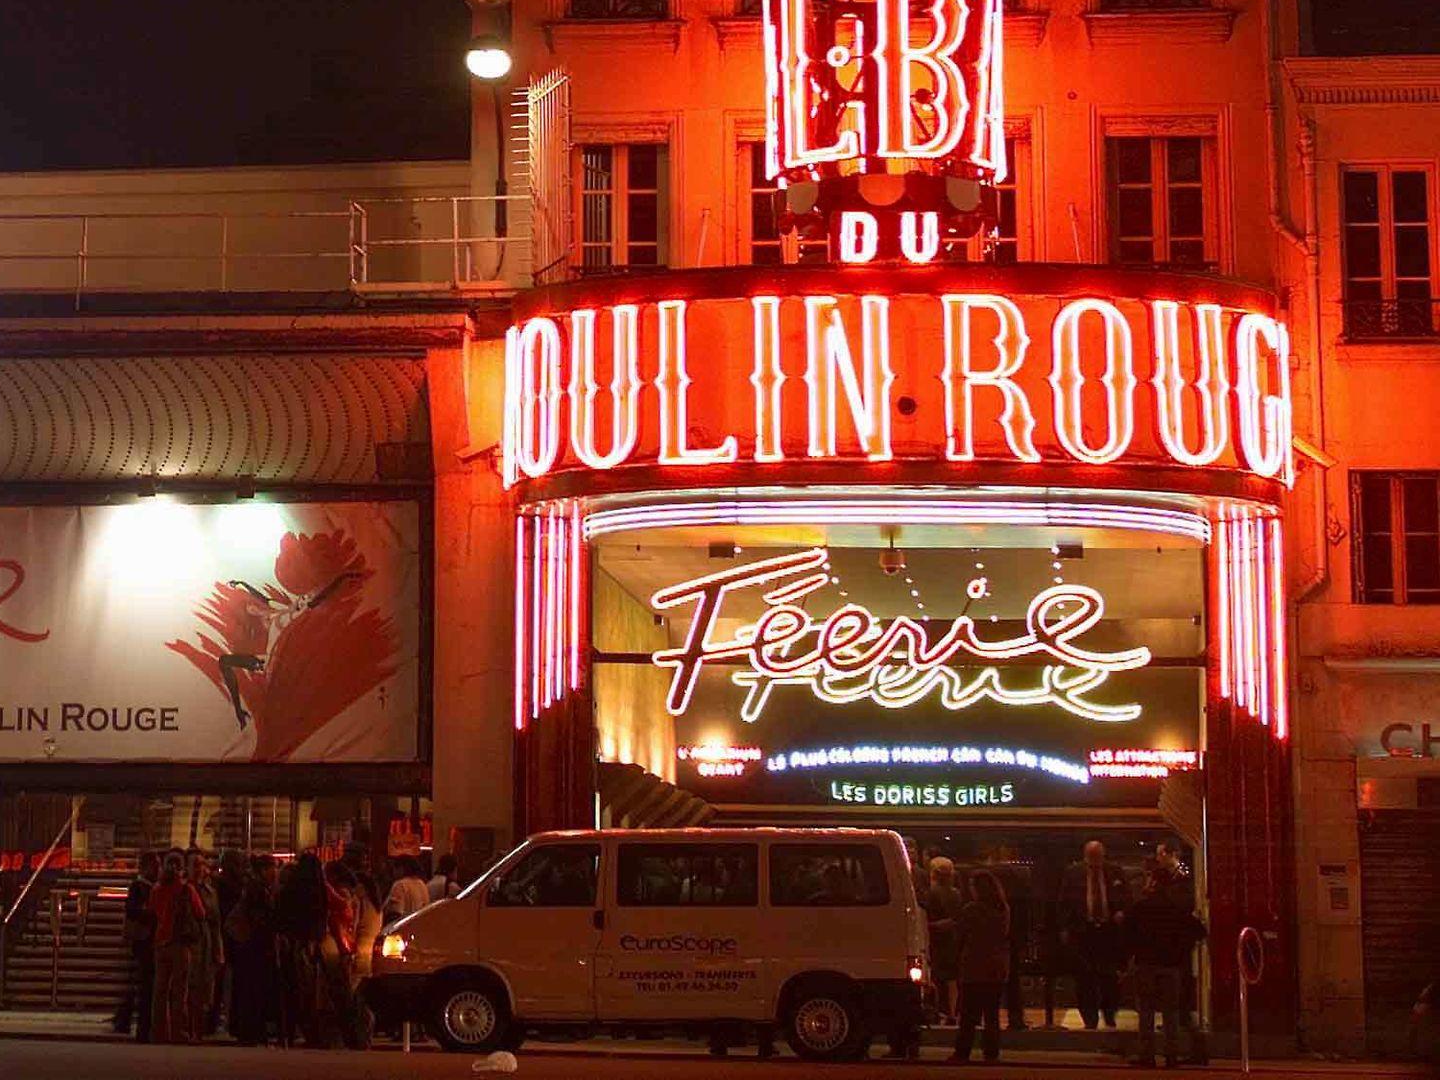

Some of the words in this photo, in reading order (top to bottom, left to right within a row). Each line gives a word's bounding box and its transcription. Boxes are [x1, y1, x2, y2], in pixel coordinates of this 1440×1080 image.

[840, 211, 939, 263] DU
[503, 295, 895, 490] OULIN
[942, 293, 1295, 490] ROUG
[652, 548, 1152, 717] Féerie
[60, 703, 180, 732] ROUGE
[831, 781, 867, 803] LES
[873, 784, 951, 806] DORISS
[955, 782, 1014, 806] GIRLS
